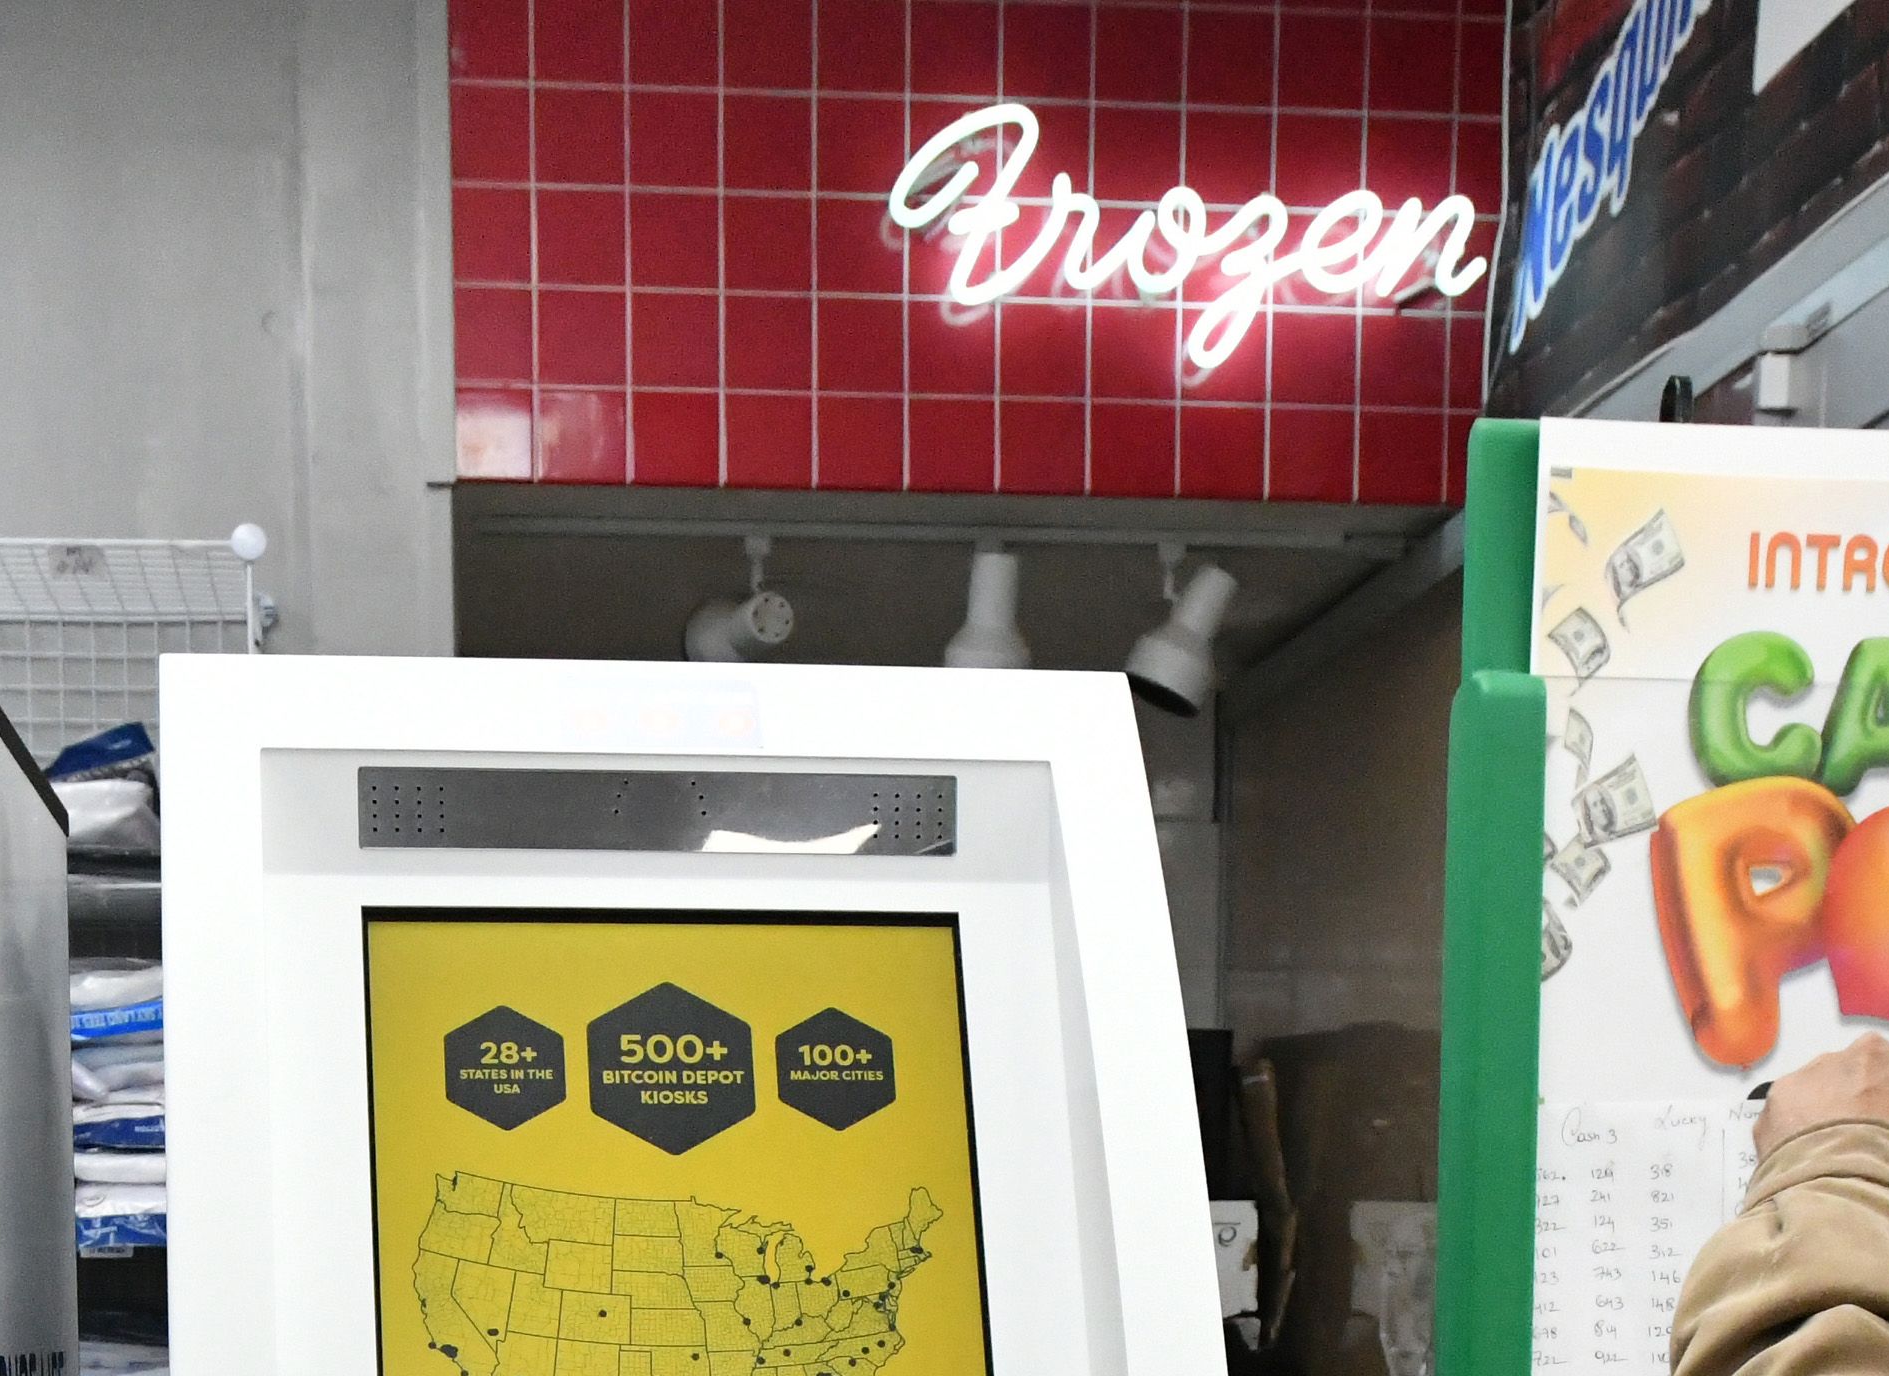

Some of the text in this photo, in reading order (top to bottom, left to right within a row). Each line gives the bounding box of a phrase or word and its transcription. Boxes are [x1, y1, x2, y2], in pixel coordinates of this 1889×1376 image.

[888, 102, 1487, 369] Frozen
[480, 1041, 538, 1065] 28+
[619, 1034, 728, 1065] 500+
[798, 1044, 873, 1066] 100+
[459, 1069, 553, 1080] STATES IN THE
[602, 1070, 745, 1086] BITCOIN DEPOT
[790, 1070, 884, 1081] MAJOR CITIES
[493, 1083, 521, 1095] USA
[640, 1090, 709, 1105] KIOSKS
